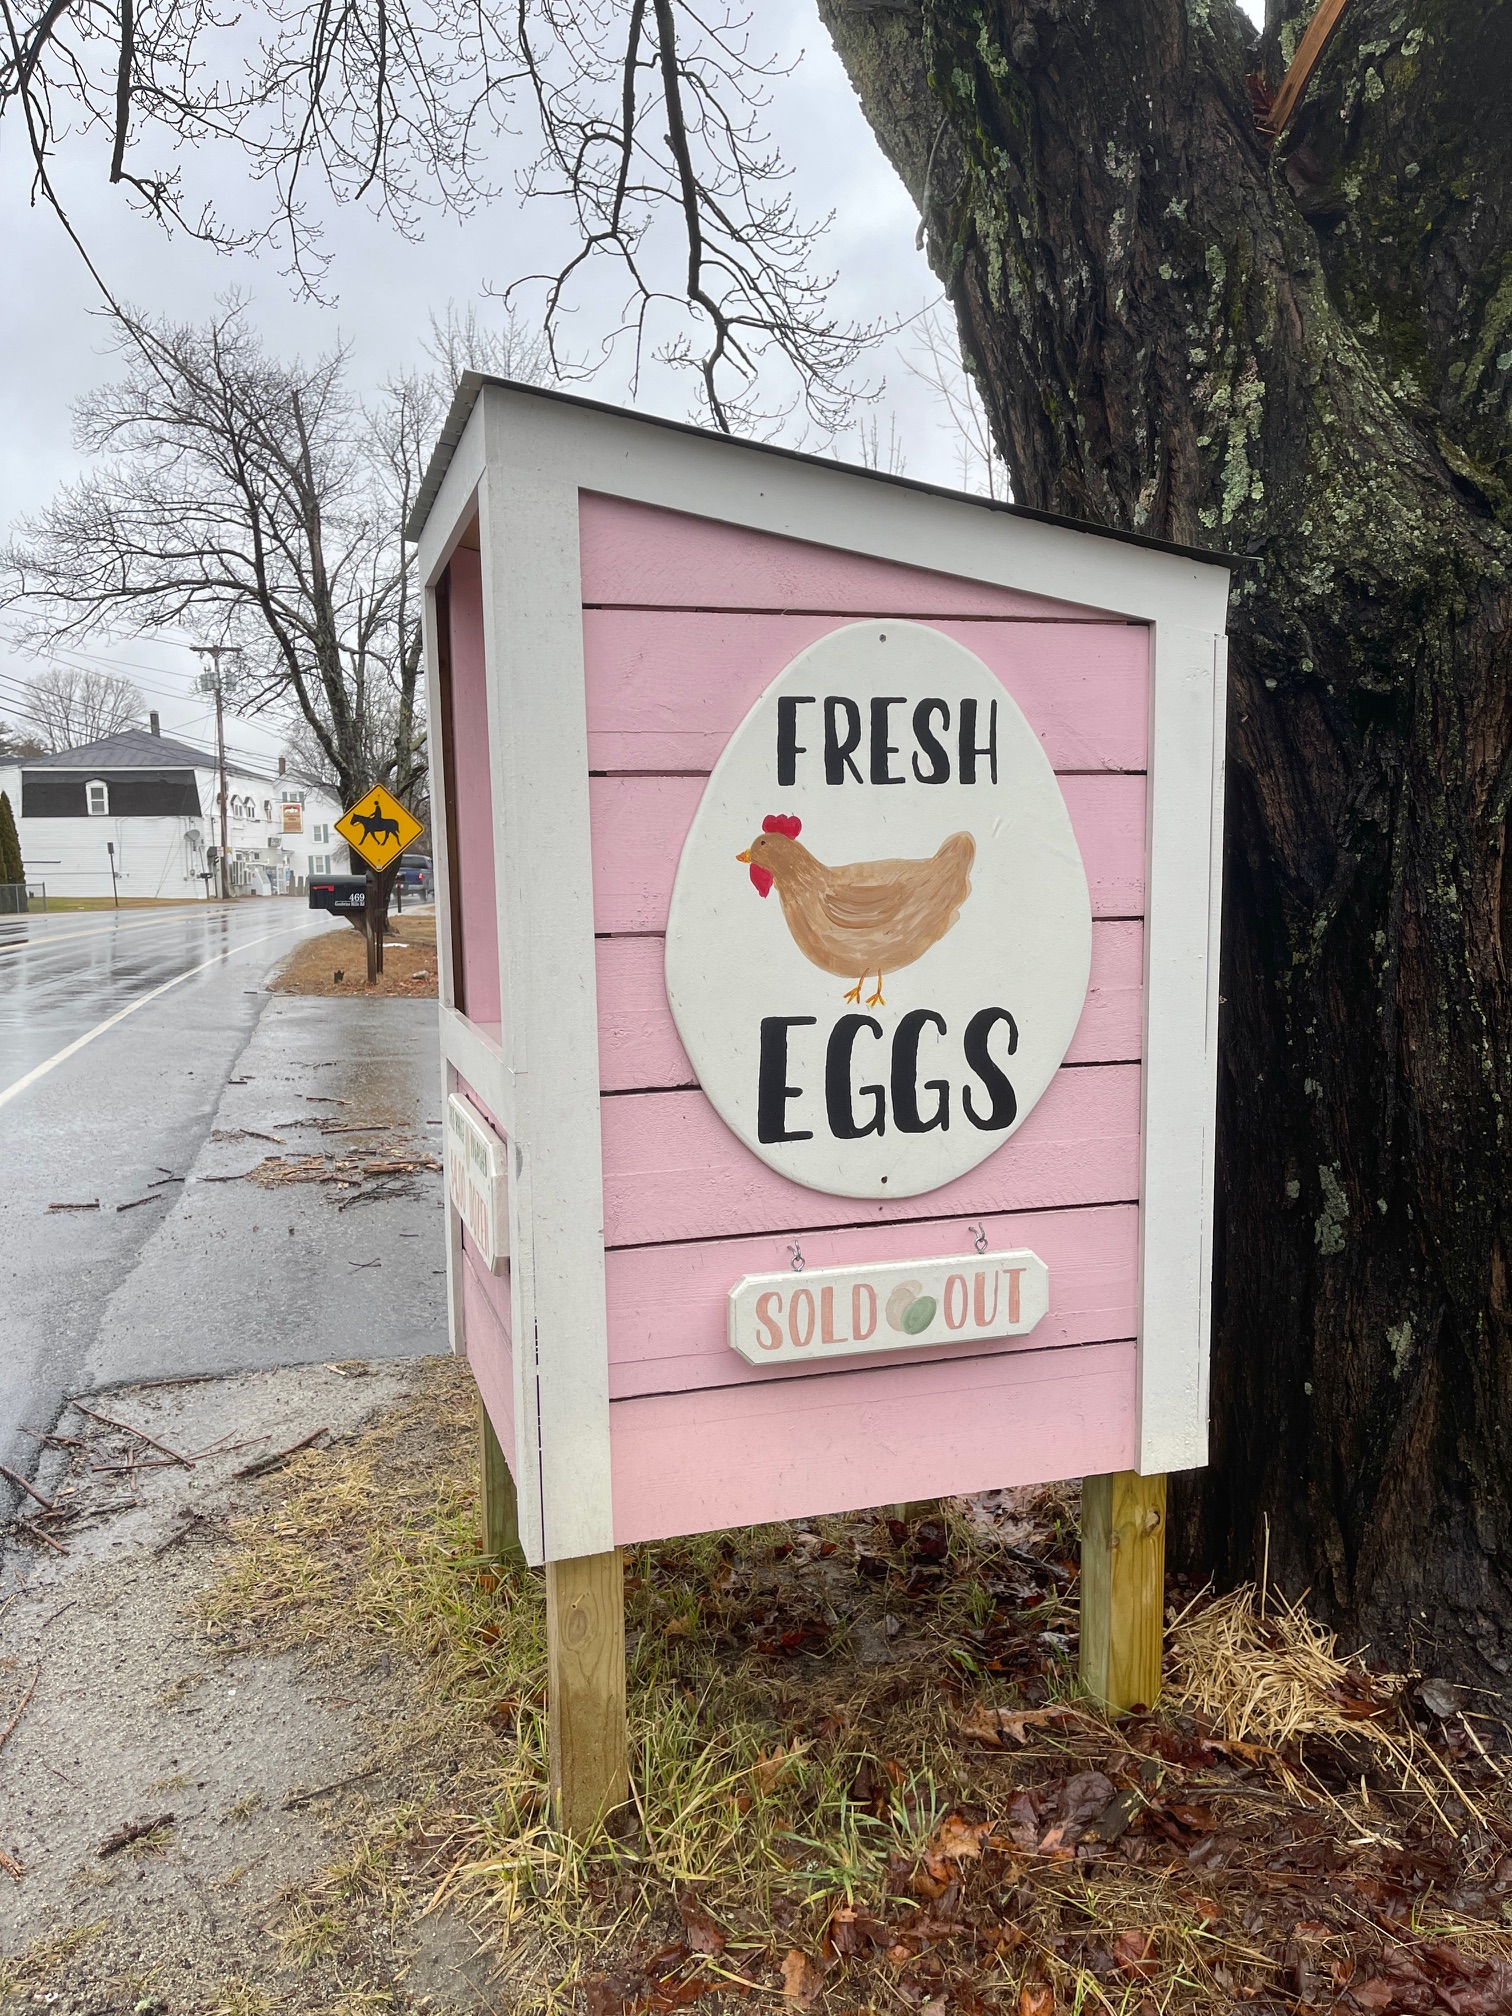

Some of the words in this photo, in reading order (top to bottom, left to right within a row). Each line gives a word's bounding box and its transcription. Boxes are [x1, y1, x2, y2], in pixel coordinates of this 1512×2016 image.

[777, 696, 997, 786] FRESH
[349, 893, 365, 901] 469
[758, 1007, 1018, 1144] EGGS
[756, 1284, 877, 1350] SOLD
[944, 1267, 1027, 1329] OUT
